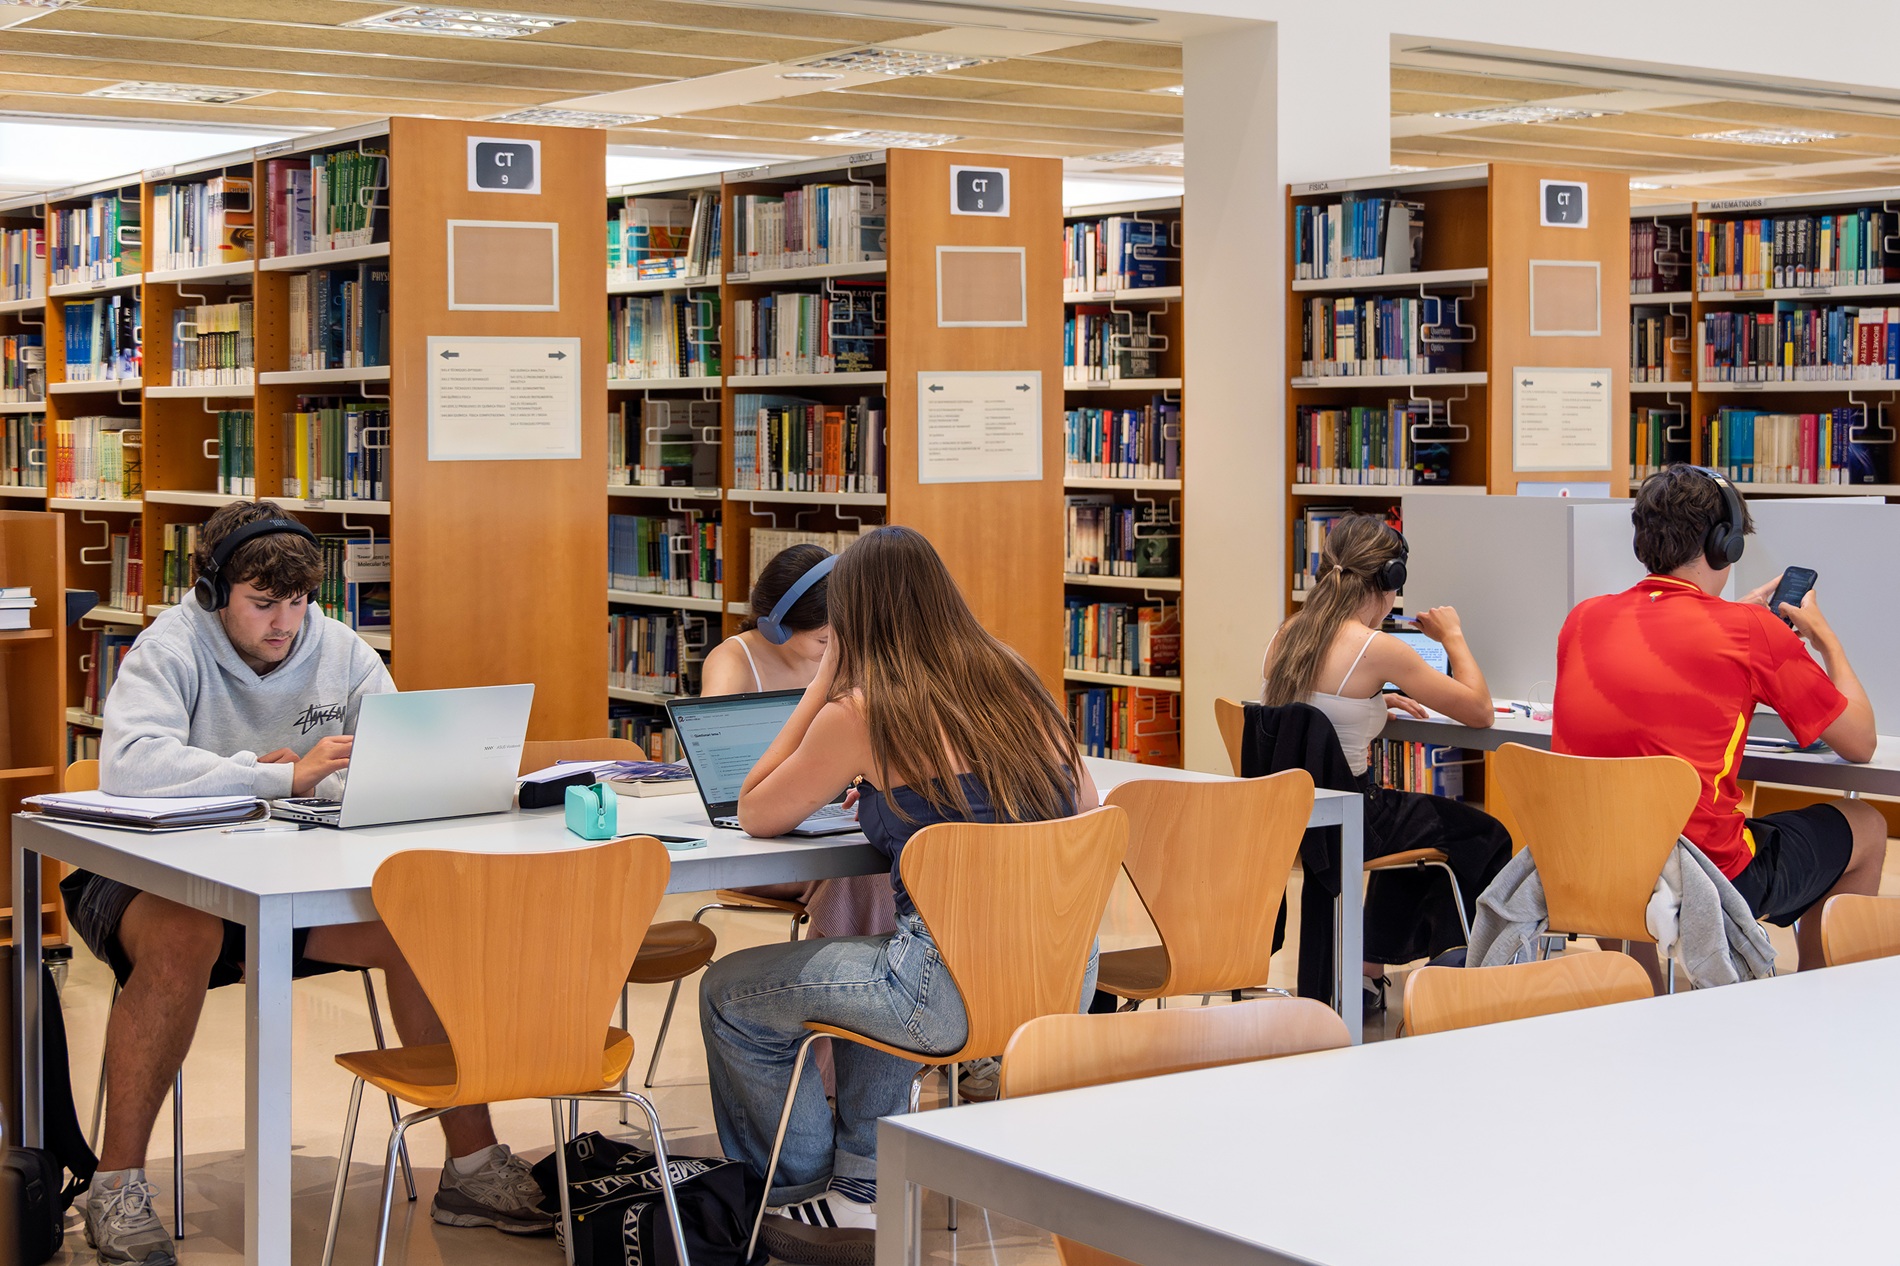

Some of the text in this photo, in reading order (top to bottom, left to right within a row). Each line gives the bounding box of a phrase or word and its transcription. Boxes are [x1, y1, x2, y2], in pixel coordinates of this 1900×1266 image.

[494, 152, 514, 167] CT
[501, 174, 509, 185] 9
[972, 178, 988, 192] CT
[977, 199, 984, 209] 8
[1557, 192, 1570, 206] CT
[1561, 211, 1567, 220] 7
